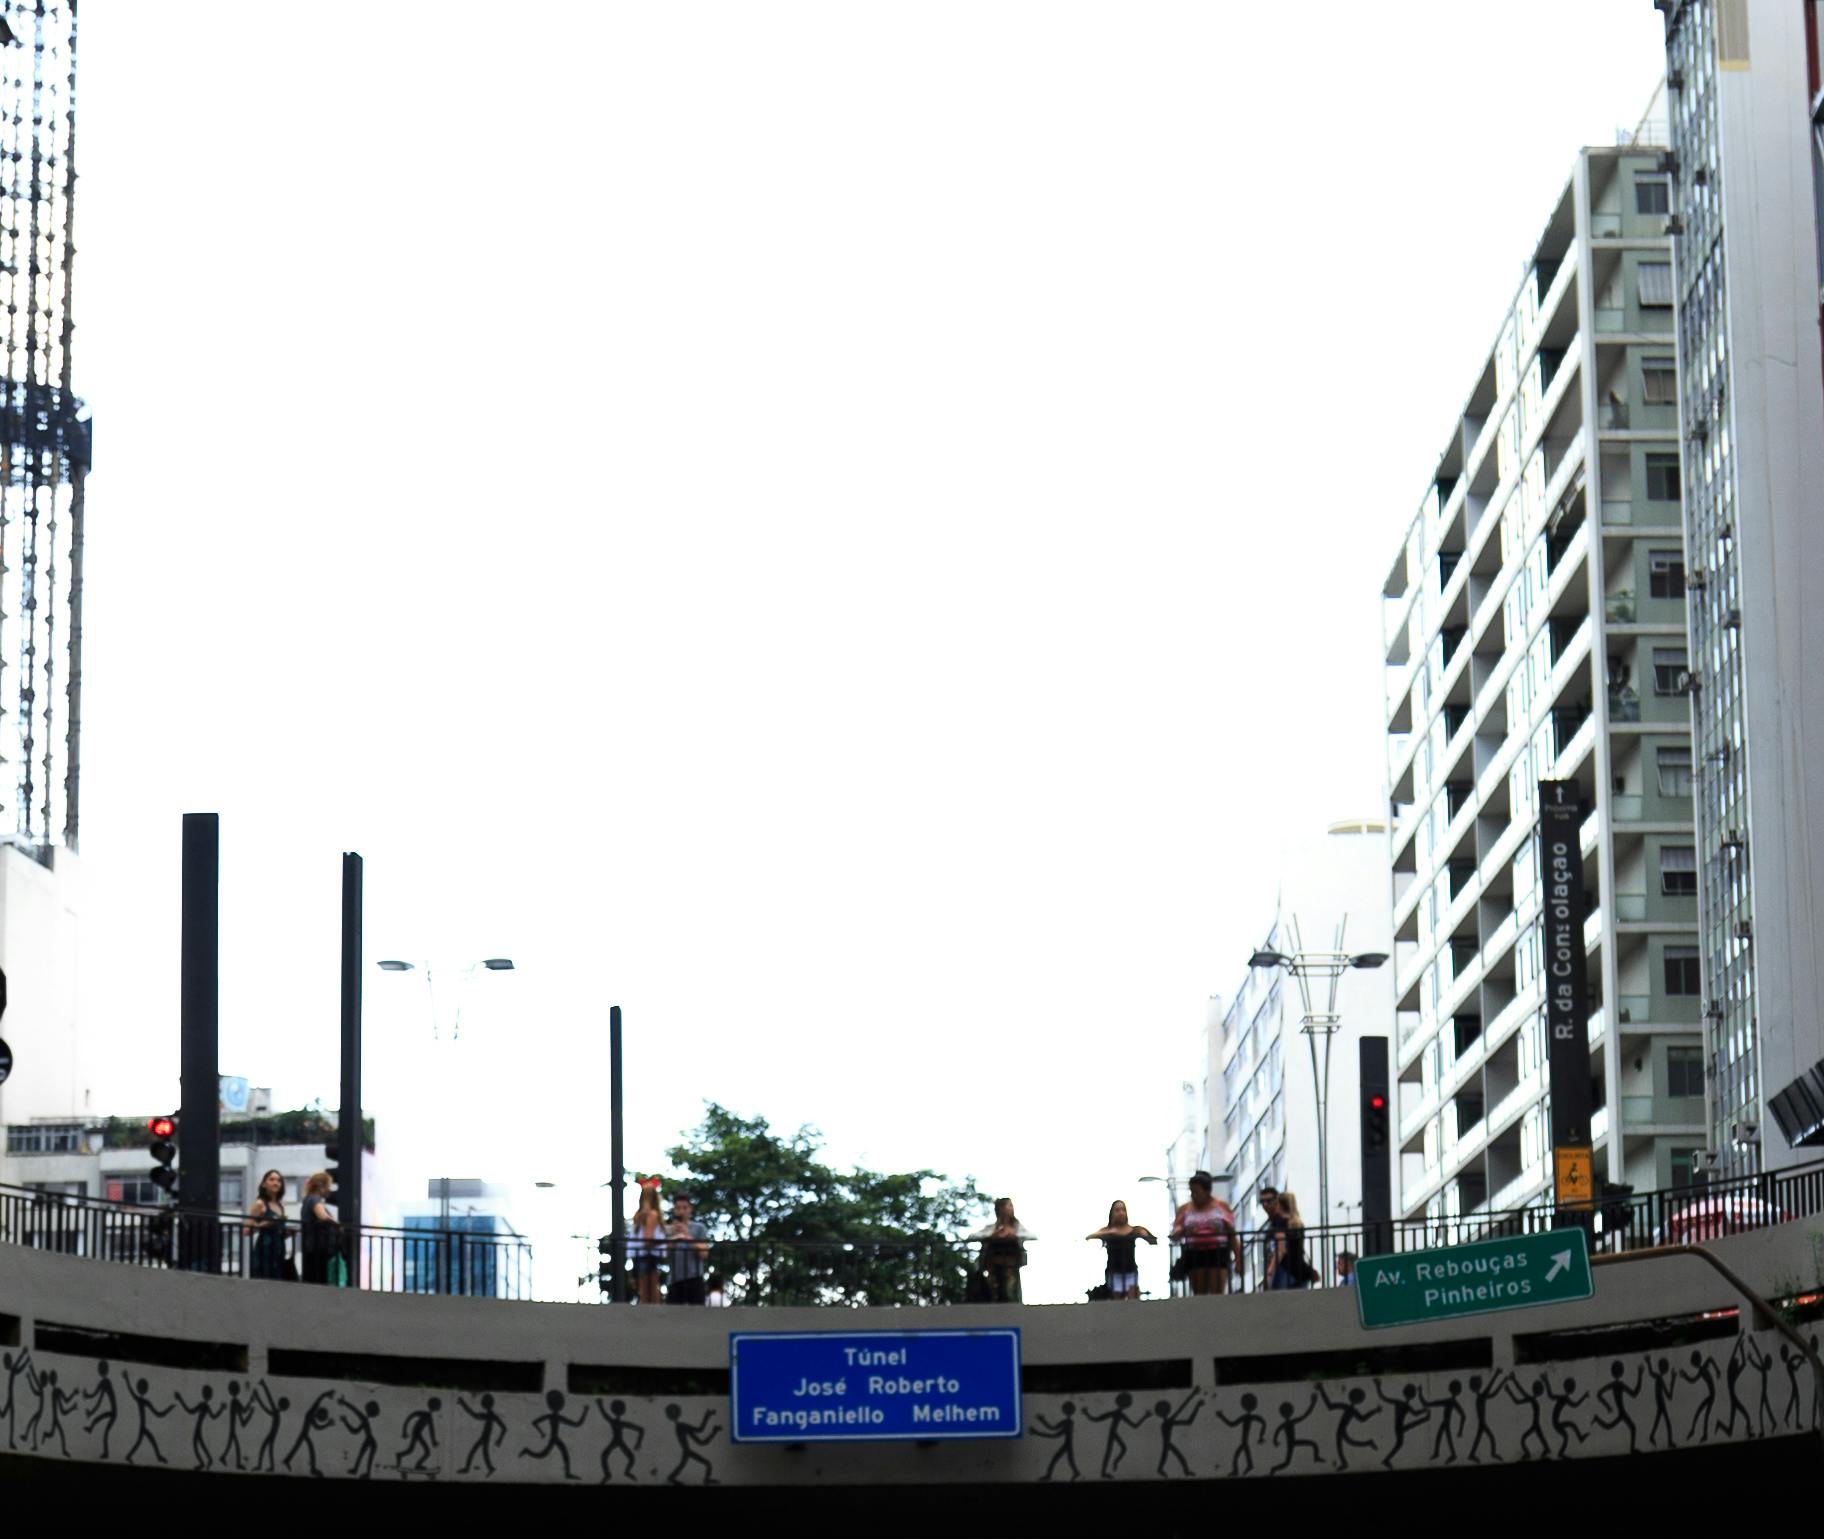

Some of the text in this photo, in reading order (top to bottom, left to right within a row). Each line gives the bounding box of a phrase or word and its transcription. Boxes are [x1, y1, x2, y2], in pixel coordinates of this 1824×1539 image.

[1554, 984, 1573, 1012] da
[1555, 1017, 1575, 1040] R.
[1374, 1251, 1529, 1289] Av. Rebouças
[1424, 1276, 1532, 1307] Pinheiros
[844, 1347, 908, 1366] Túnel
[793, 1376, 960, 1397] José Roberto
[752, 1404, 1000, 1430] Fanganiello Melhem
